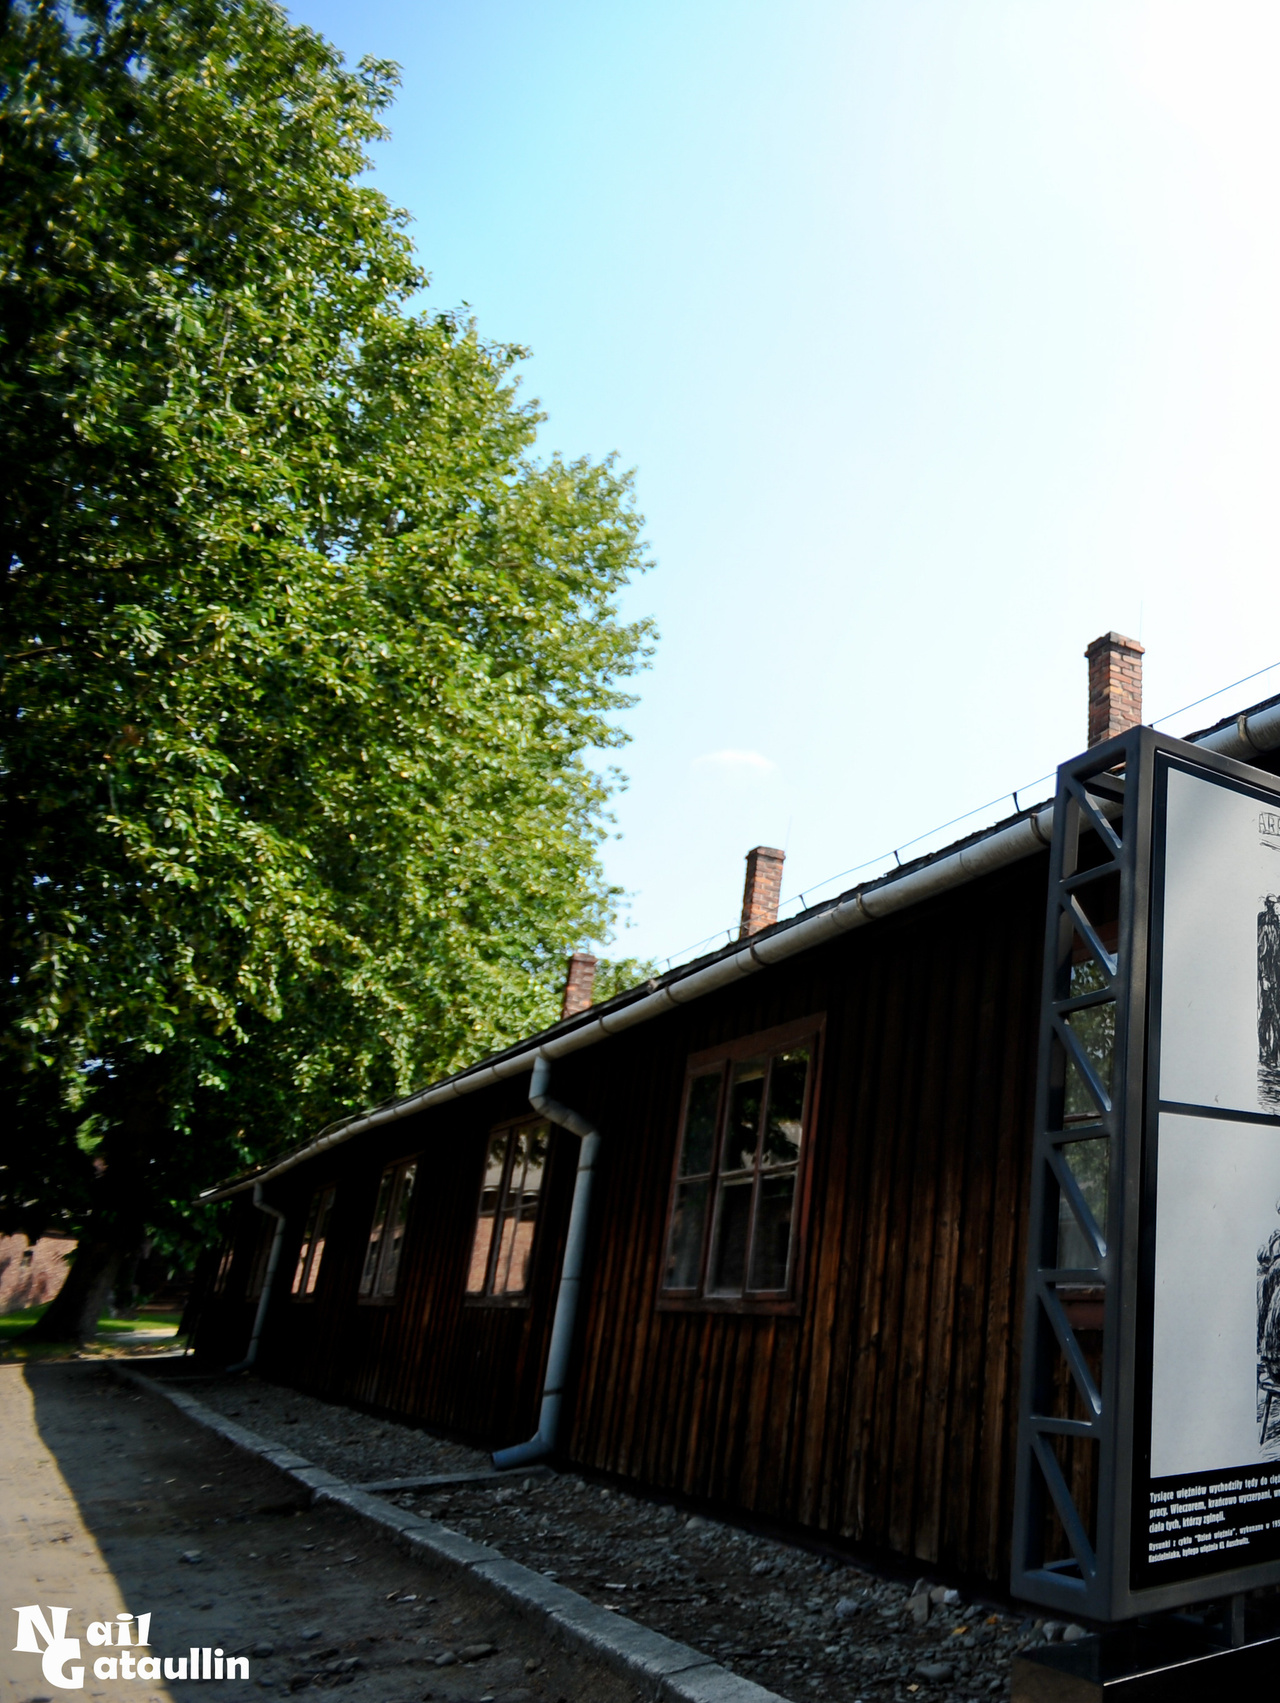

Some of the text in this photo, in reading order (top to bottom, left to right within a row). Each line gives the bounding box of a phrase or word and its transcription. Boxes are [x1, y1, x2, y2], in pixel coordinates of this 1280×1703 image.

[1149, 1507, 1169, 1519] pracy.
[1170, 1501, 1207, 1515] Wieczorem,
[1208, 1496, 1237, 1509] krańcowo
[1238, 1489, 1272, 1504] wyczerpani,
[1150, 1491, 1174, 1504] Tysiące
[1208, 1480, 1243, 1494] wychodziły
[1244, 1477, 1259, 1489] tędy
[1260, 1476, 1268, 1486] do
[1149, 1511, 1226, 1534] ciała tych, którzy zginęli.
